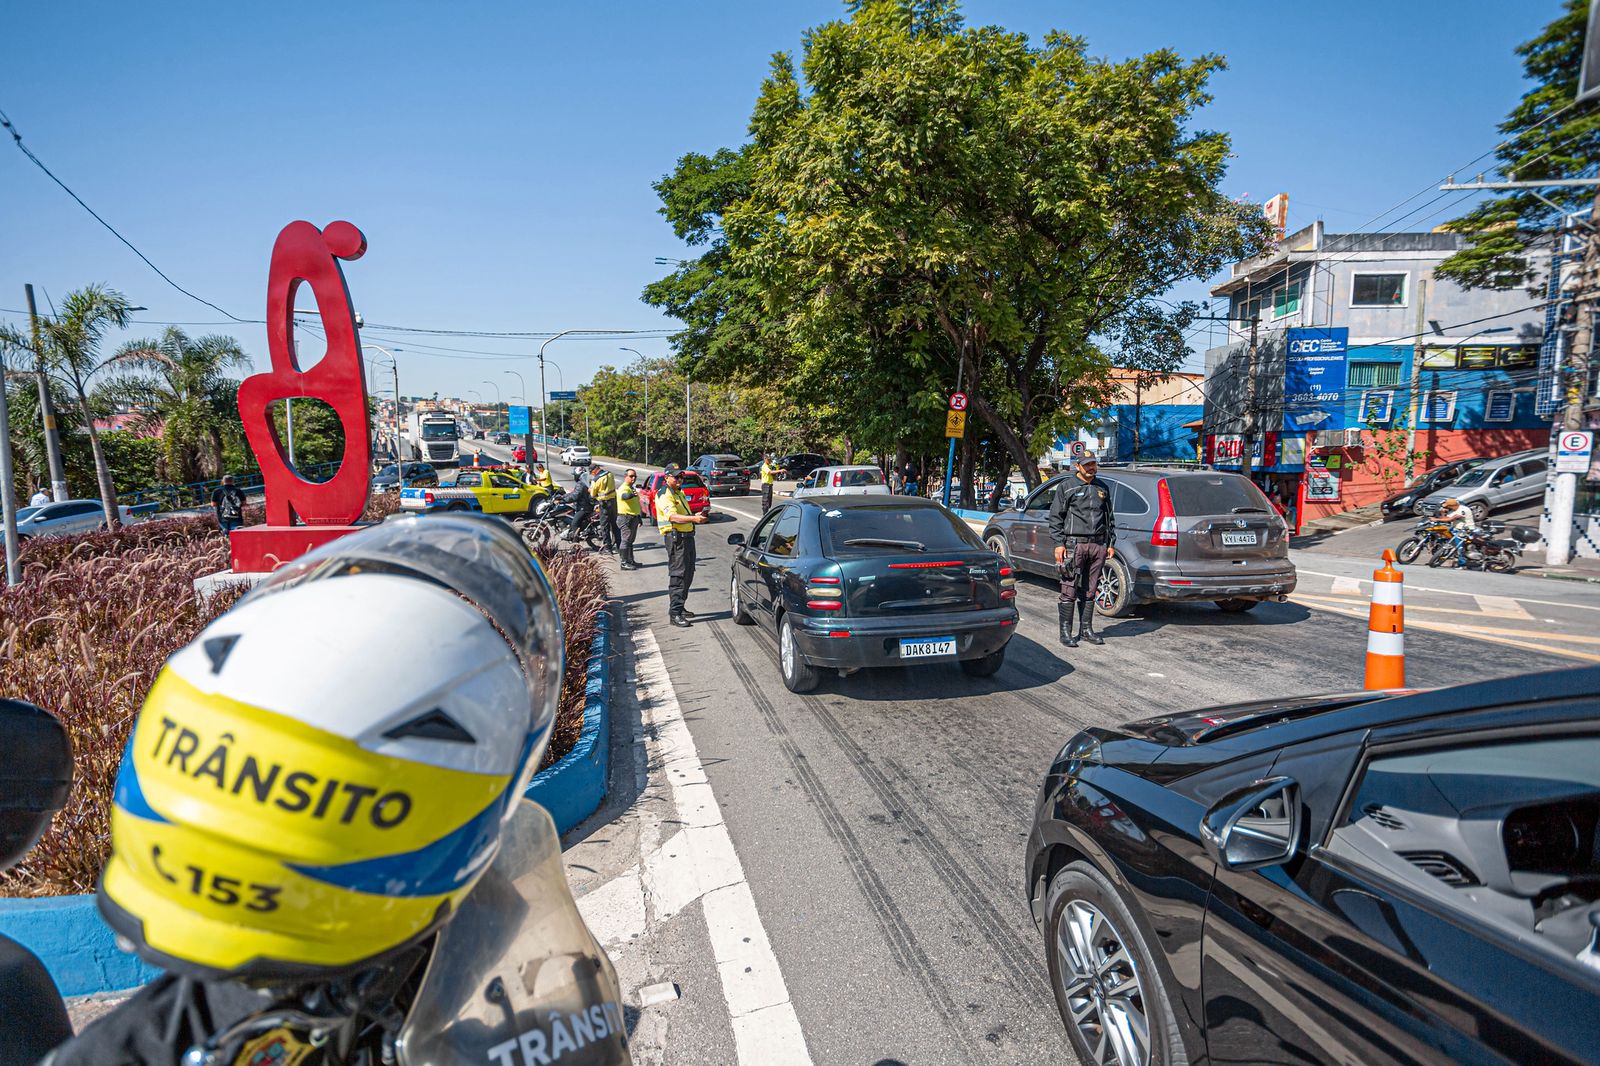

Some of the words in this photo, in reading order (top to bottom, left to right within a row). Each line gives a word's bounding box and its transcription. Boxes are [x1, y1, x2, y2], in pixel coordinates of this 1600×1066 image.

[1075, 444, 1082, 453] E
[1571, 436, 1581, 448] E
[152, 716, 413, 830] TRÂNSITO
[185, 864, 283, 913] 153
